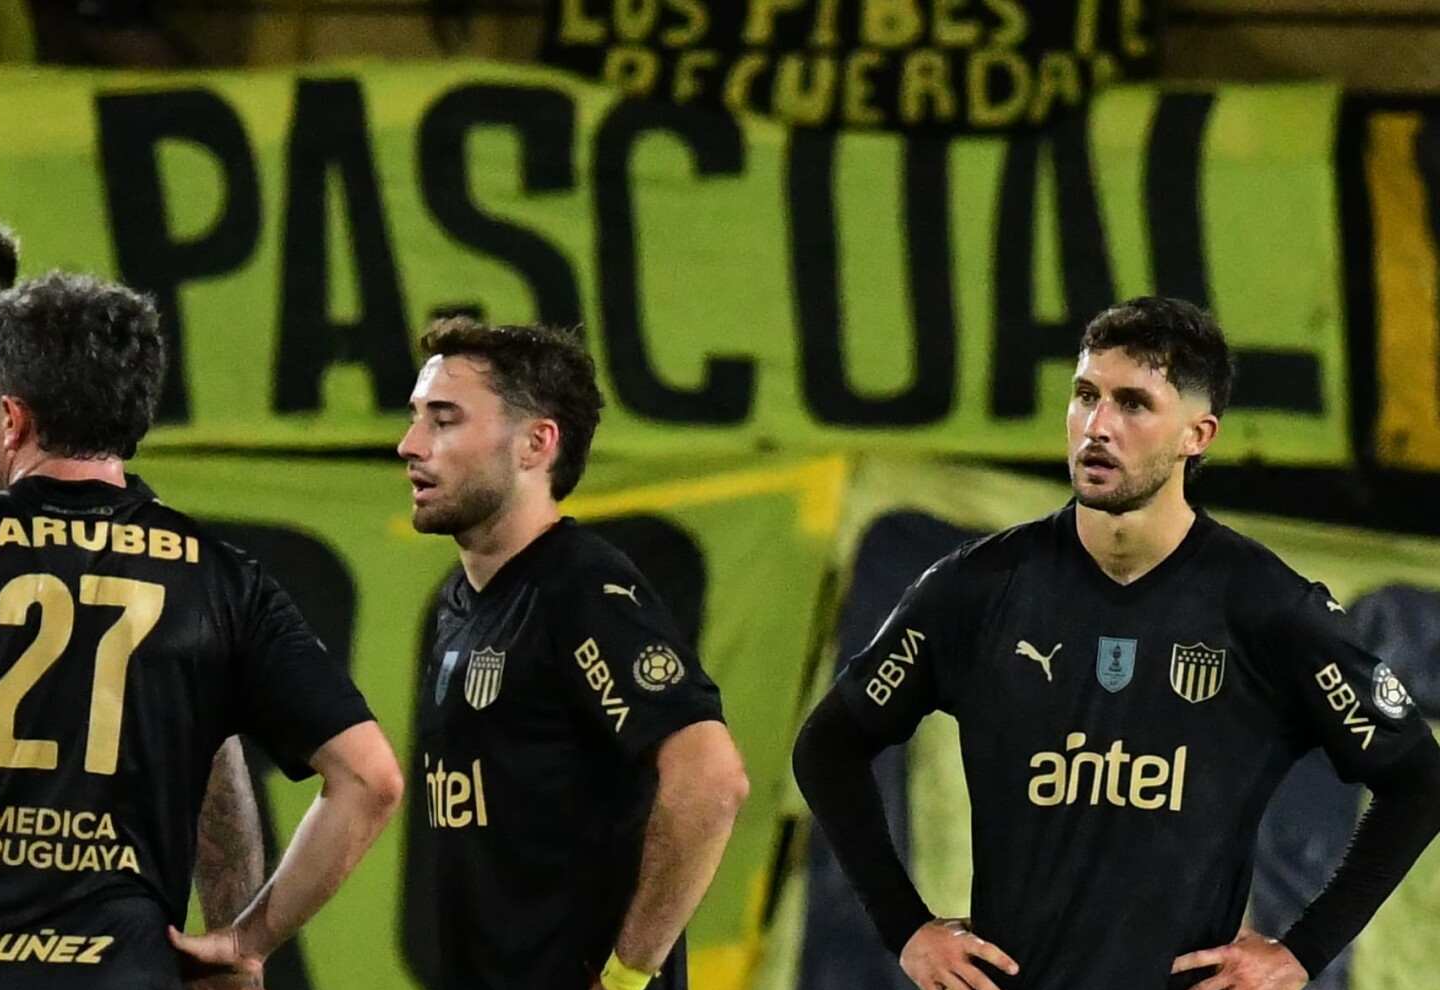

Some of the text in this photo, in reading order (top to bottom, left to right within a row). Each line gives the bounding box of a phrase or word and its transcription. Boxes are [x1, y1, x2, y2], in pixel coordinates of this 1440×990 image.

[97, 82, 1324, 428] PASCUAL
[573, 636, 630, 733] BBVA
[865, 628, 926, 707] BBVA
[1314, 662, 1376, 750] BBVA
[424, 752, 488, 829] ntel
[1028, 732, 1188, 812] antel
